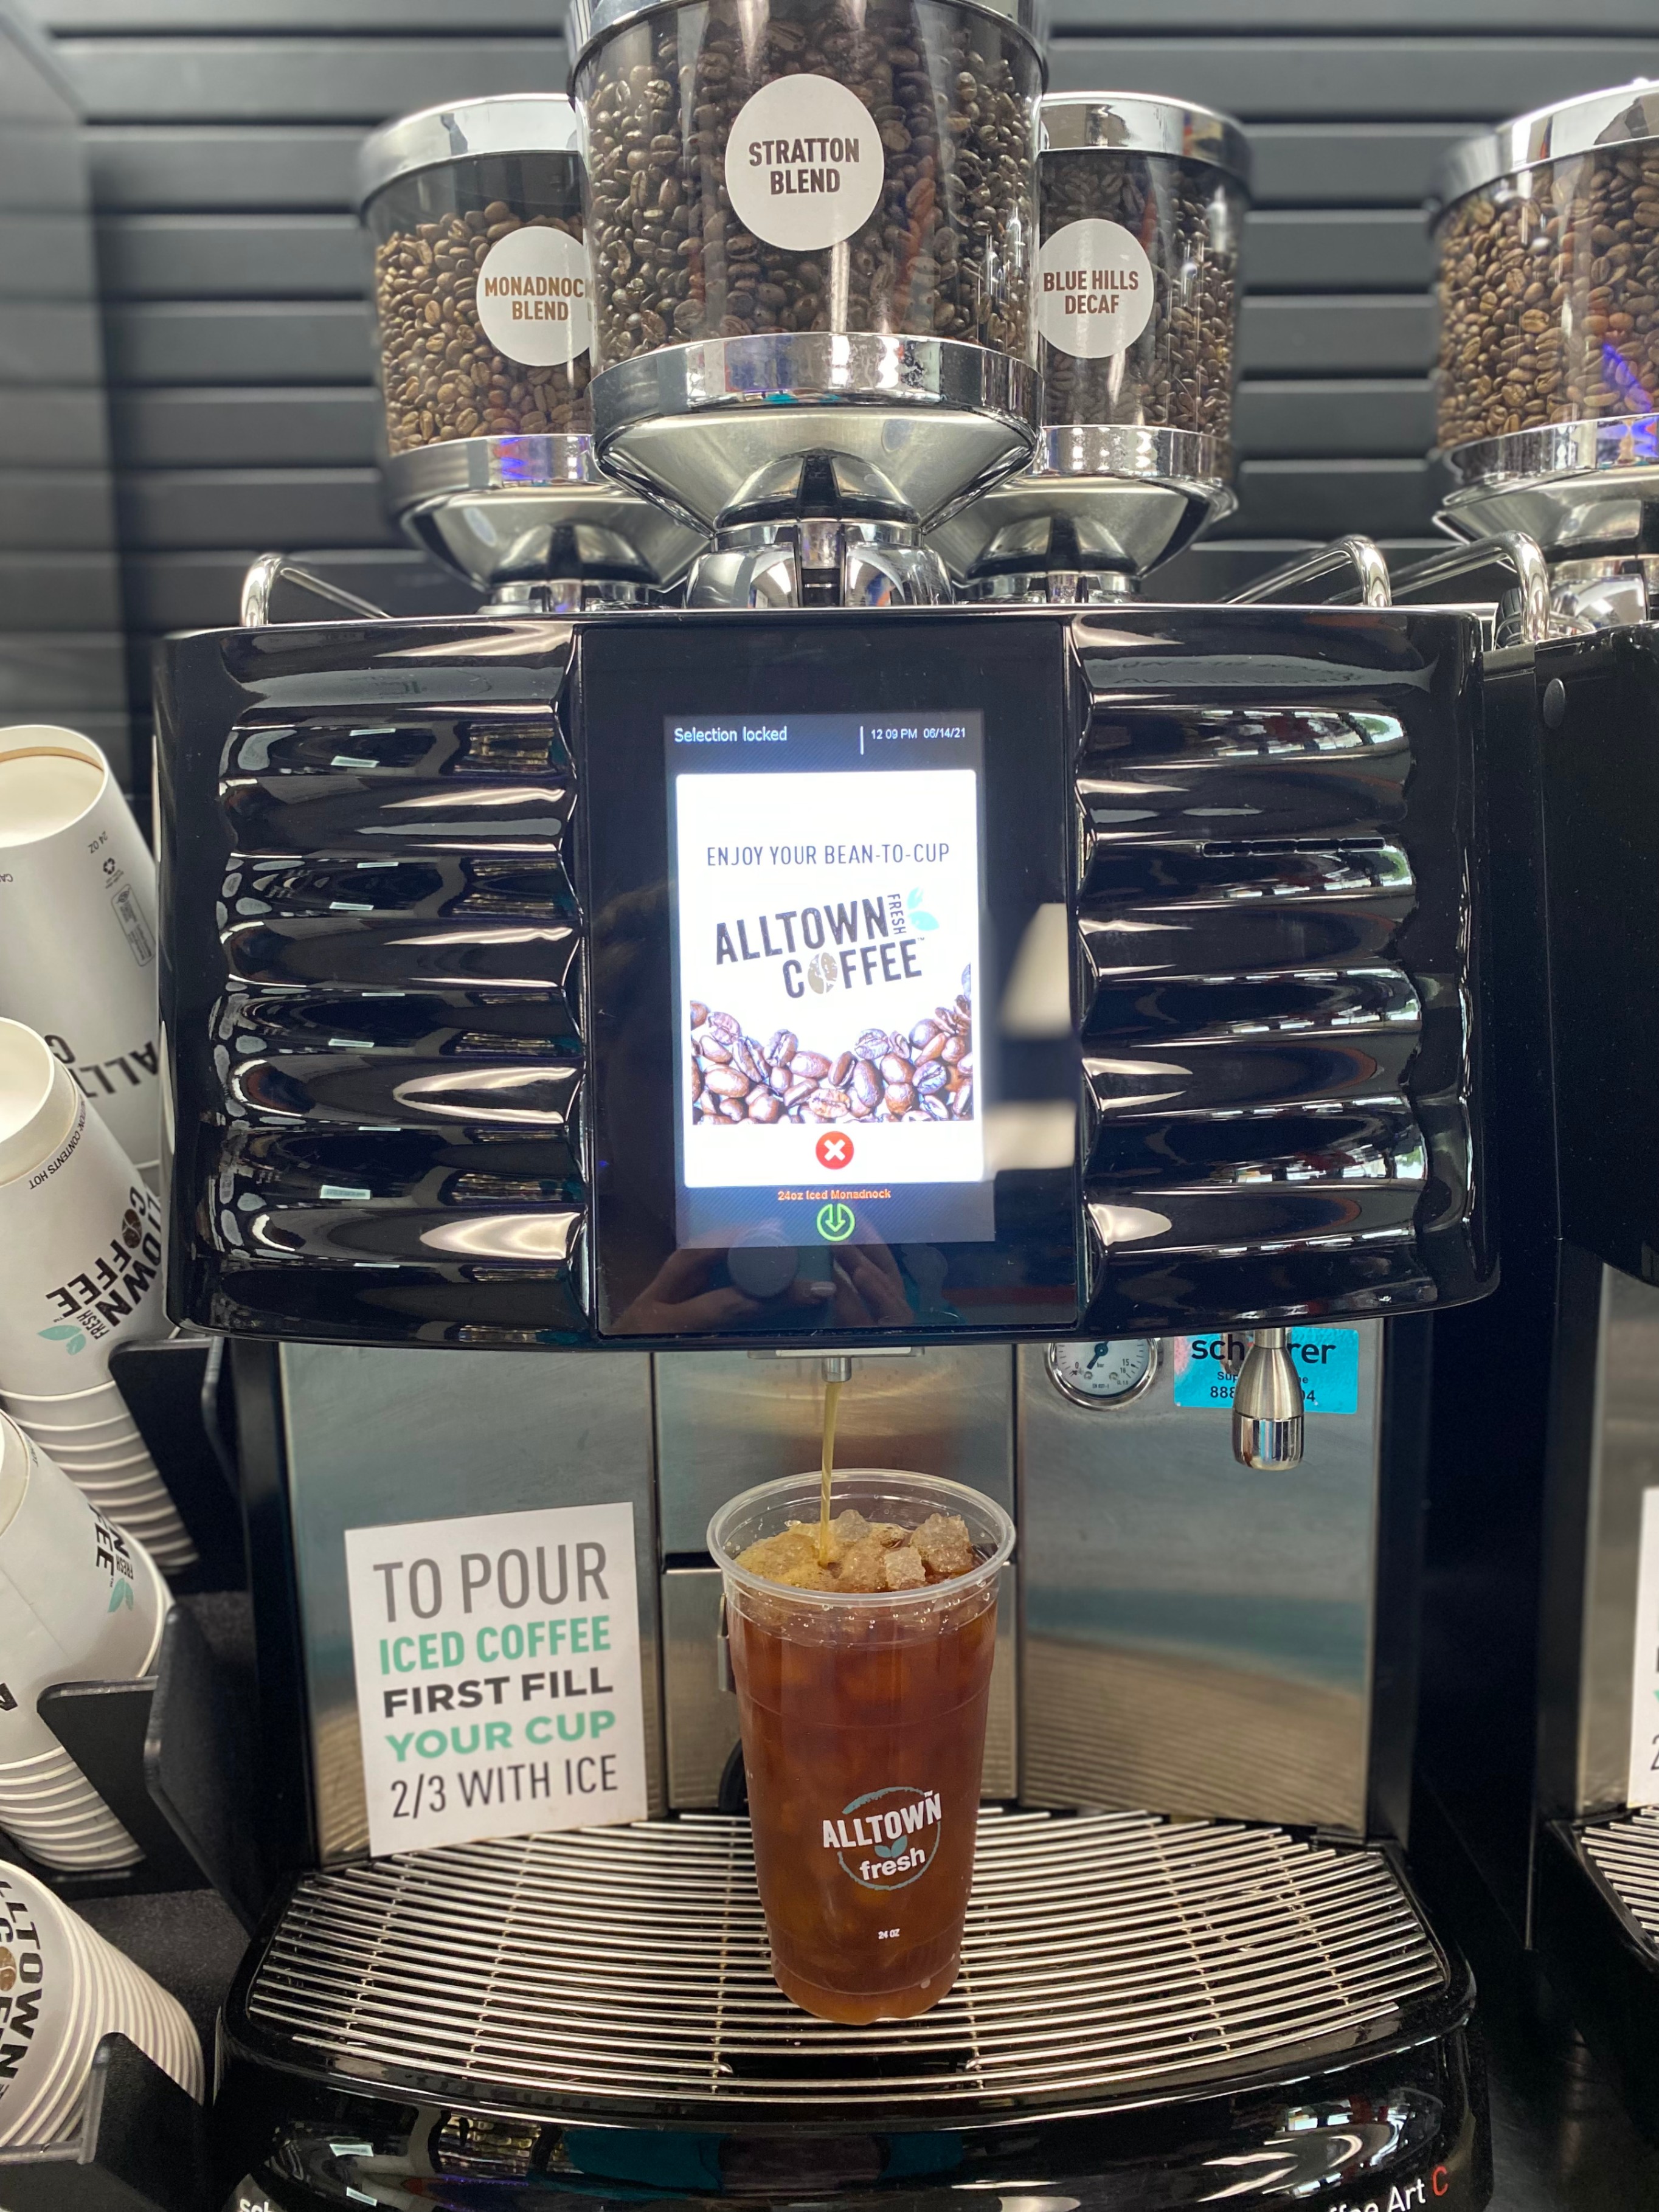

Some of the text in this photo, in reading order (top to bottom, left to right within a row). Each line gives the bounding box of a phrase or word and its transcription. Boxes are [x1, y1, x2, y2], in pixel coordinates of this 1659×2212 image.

[749, 138, 860, 167] STRATTON
[770, 168, 840, 195] BLEND
[485, 276, 587, 298] MONADNOC
[1043, 270, 1139, 292] BLUE HILLS
[511, 300, 569, 321] BLEND
[1065, 294, 1120, 314] DECAF
[674, 725, 788, 742] Selection locked
[901, 728, 918, 739] PM
[923, 727, 966, 739] 06/14/21
[707, 843, 950, 866] ENJOY YOUR BEAN-TO-CUP
[887, 893, 907, 935] FRESH
[716, 896, 889, 966] ALLTOWN
[29, 1130, 81, 1190] CONTENTS HOT
[777, 1189, 892, 1201] 24oz Iced Monadnock
[76, 1309, 110, 1340] FRESH
[373, 1541, 610, 1623] TO POUR
[379, 1615, 611, 1675] ICED COFFEE
[383, 1667, 614, 1719] FIRST FILL
[384, 1710, 616, 1762] YOUR CUP
[390, 1754, 618, 1819] 2/3 WITH ICE
[822, 1792, 942, 1848] ALLTOWN
[859, 1847, 926, 1881] fresh
[1388, 2165, 1449, 2212] Art C
